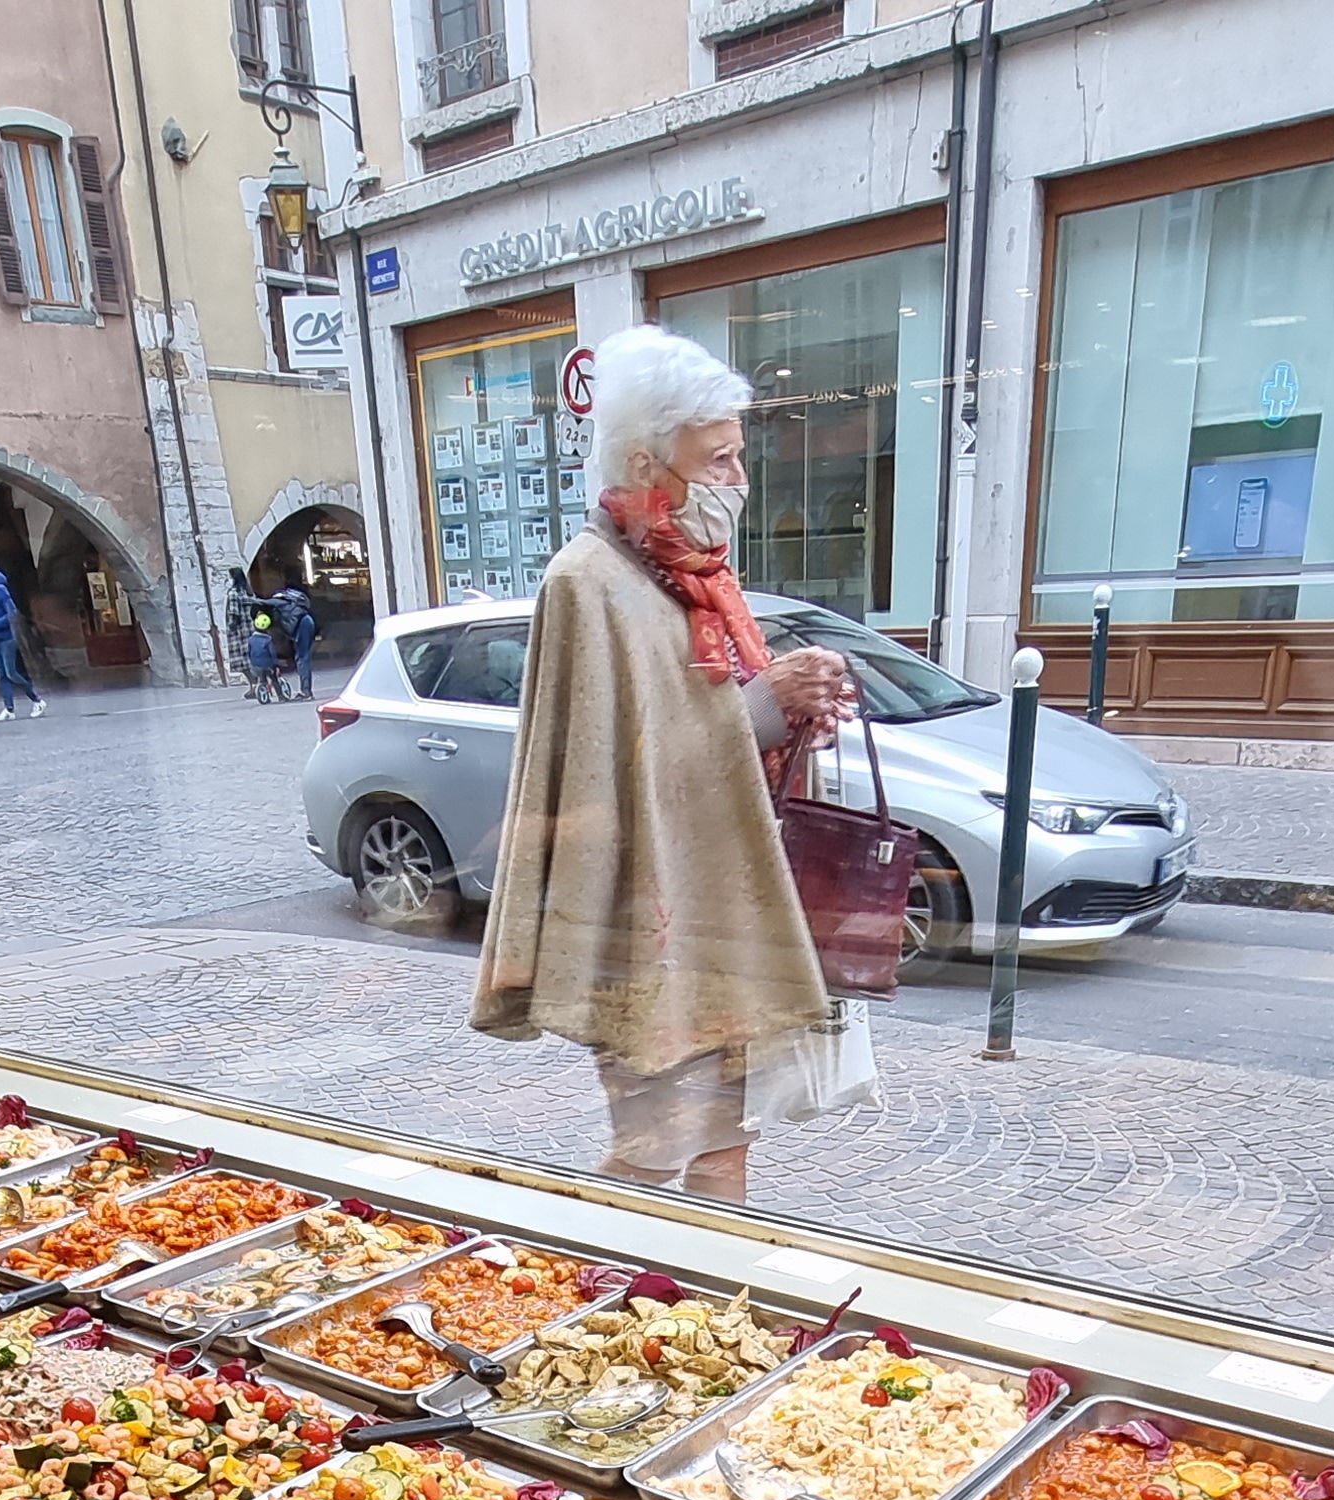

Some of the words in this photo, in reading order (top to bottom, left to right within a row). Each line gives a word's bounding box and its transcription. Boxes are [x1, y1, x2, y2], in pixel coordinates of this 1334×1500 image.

[459, 223, 564, 281] CRÉDIT
[574, 176, 746, 253] AGRICOLE
[565, 427, 579, 443] 2,2
[580, 434, 588, 443] m
